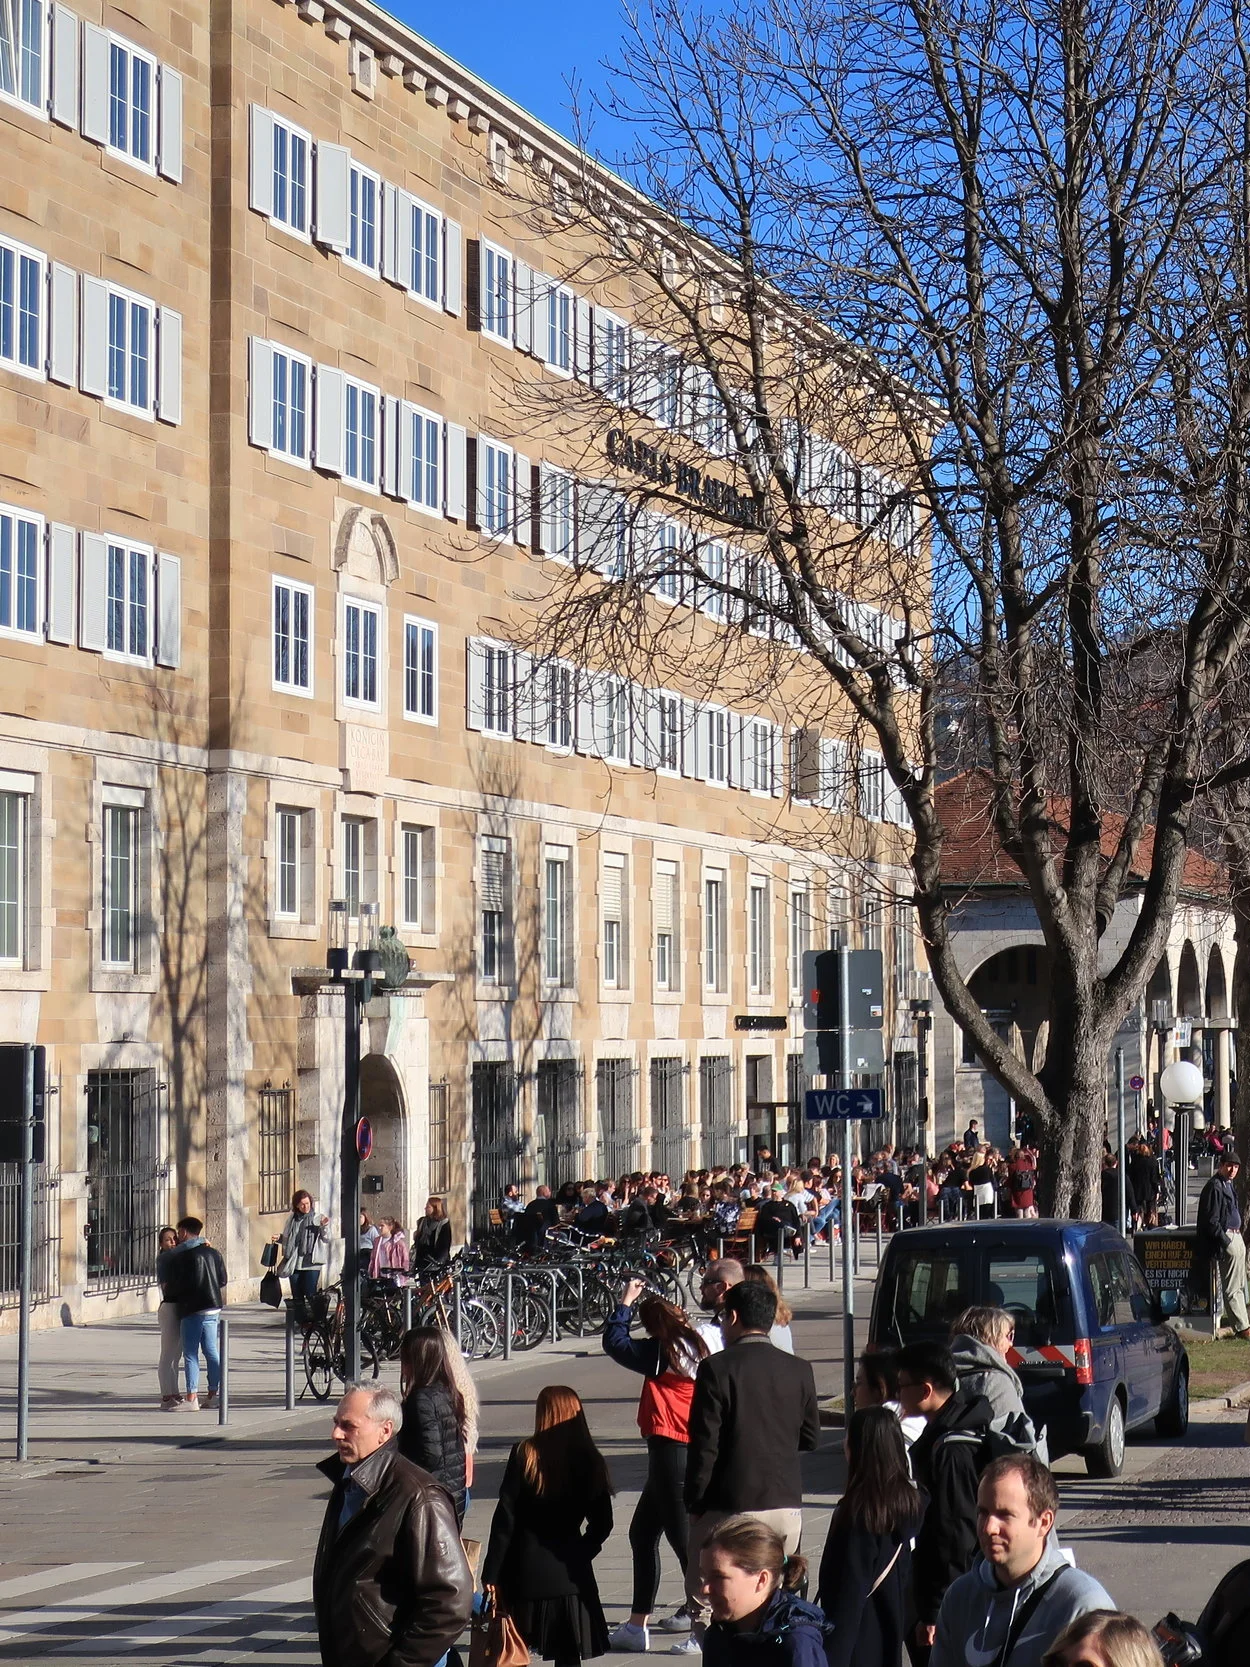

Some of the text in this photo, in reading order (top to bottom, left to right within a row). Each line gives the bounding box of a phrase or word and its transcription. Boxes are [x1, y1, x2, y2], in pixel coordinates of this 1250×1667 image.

[815, 1094, 851, 1115] WC
[1144, 1240, 1186, 1250] WIR HABEN
[1144, 1250, 1193, 1260] EINEN RUF ZU
[1145, 1269, 1190, 1279] ES IST NICHT
